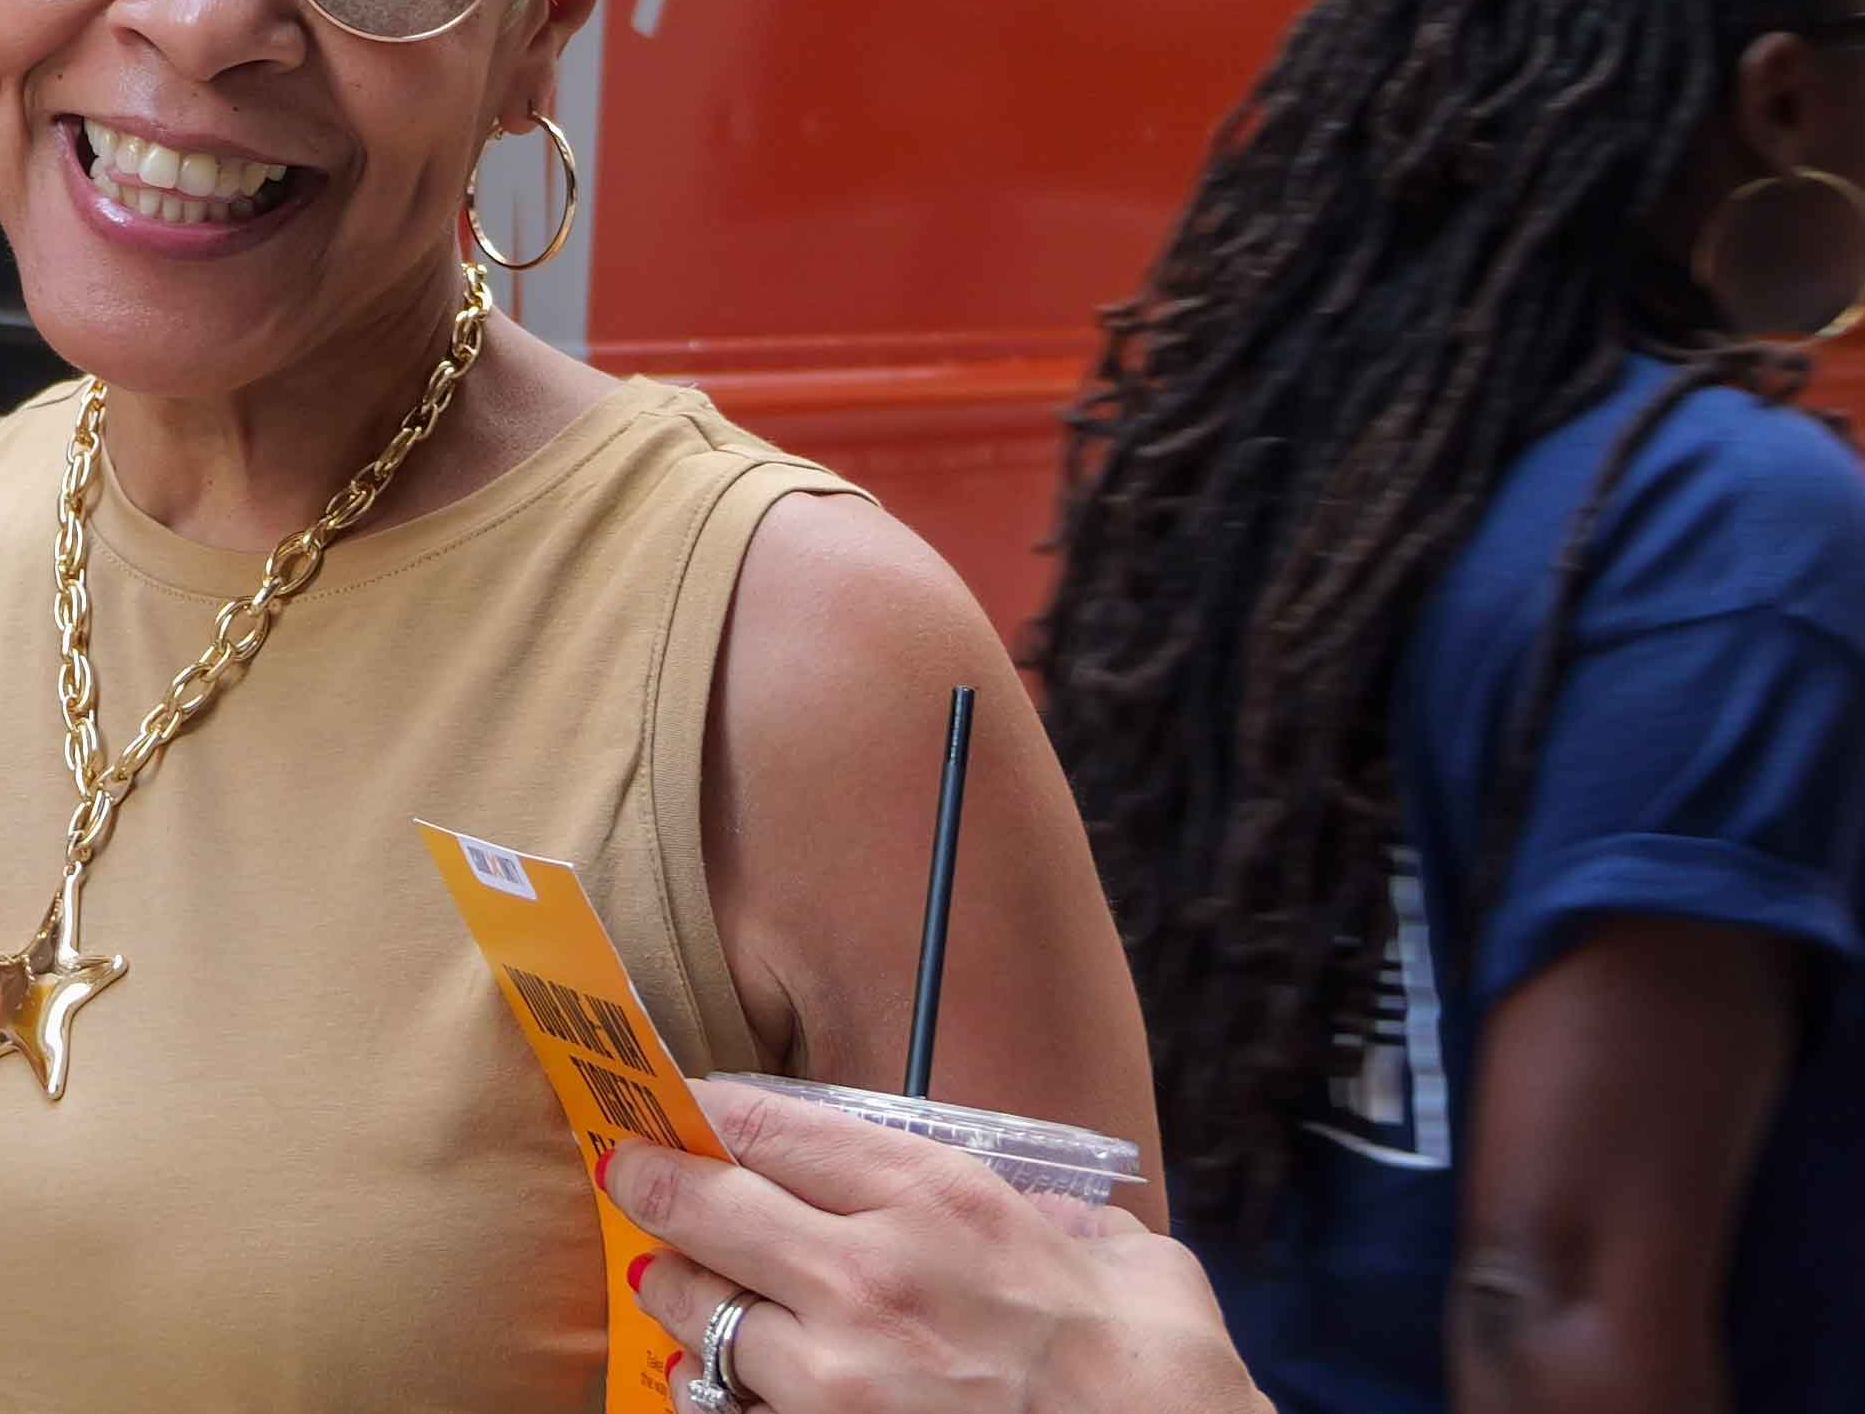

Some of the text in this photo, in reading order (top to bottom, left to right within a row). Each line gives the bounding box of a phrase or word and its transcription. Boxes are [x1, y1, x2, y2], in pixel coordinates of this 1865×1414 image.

[501, 962, 657, 1078] YOUR ONE-WAY
[569, 1054, 688, 1153] TICKET TO
